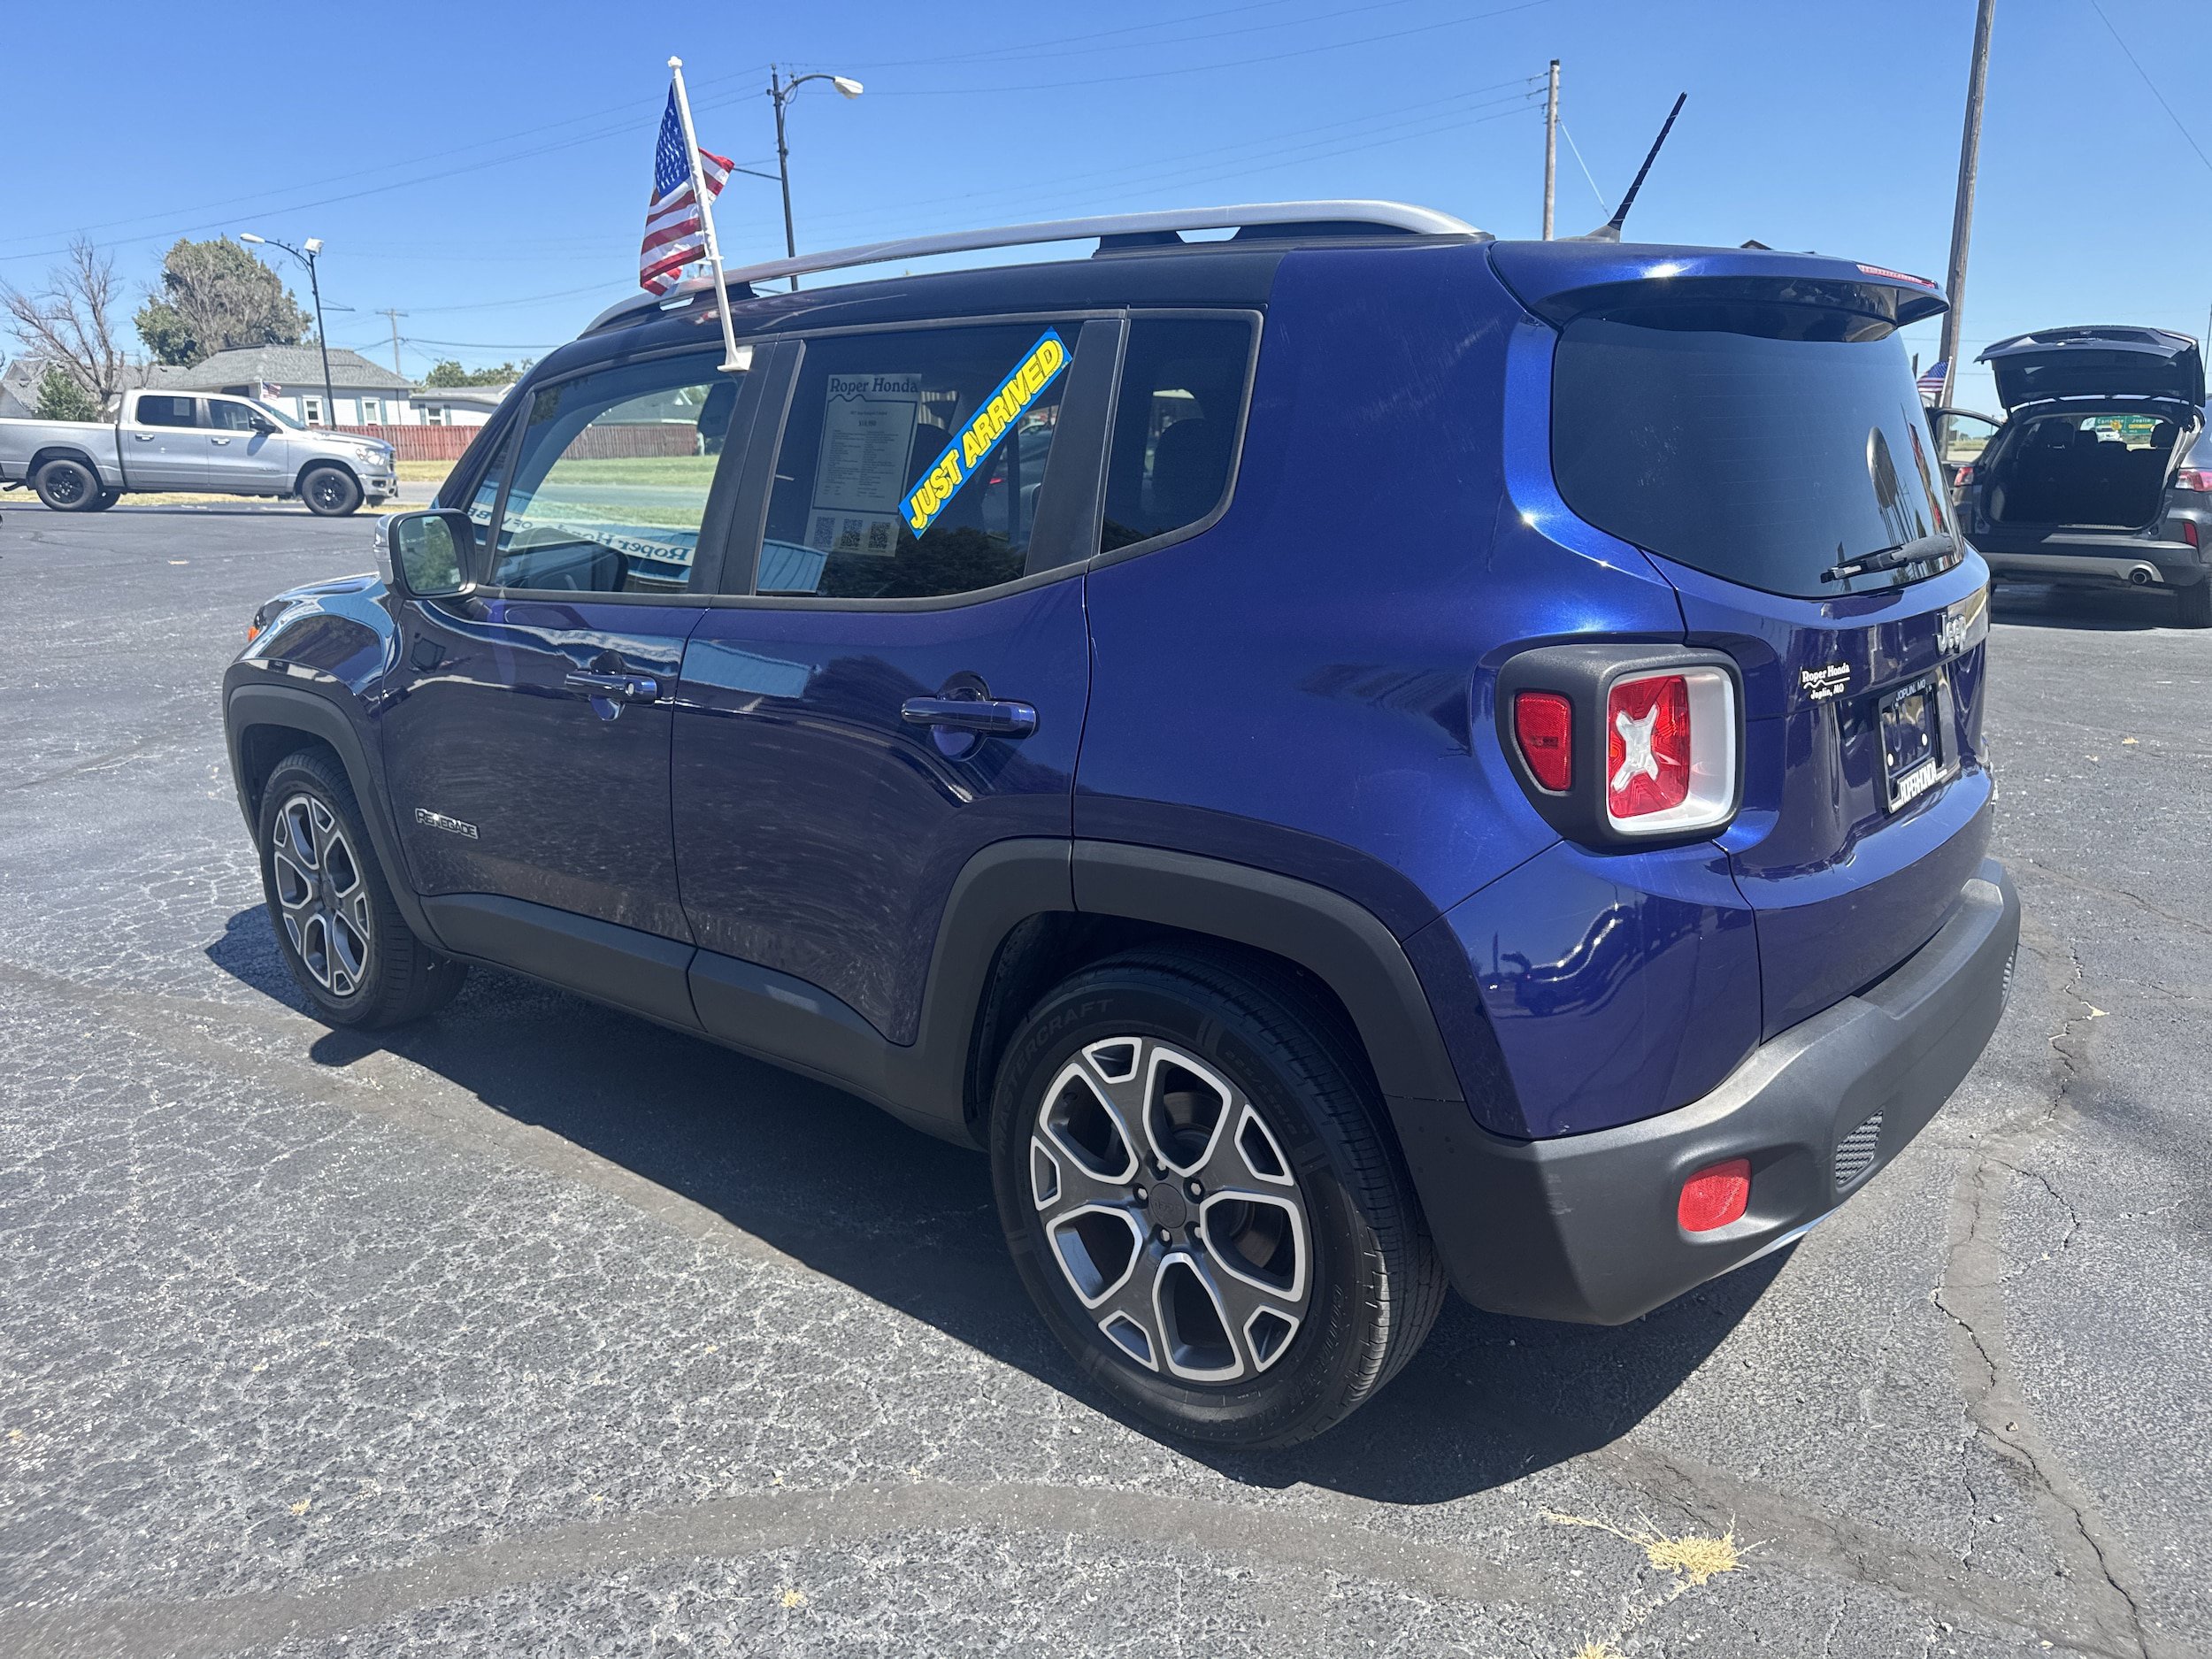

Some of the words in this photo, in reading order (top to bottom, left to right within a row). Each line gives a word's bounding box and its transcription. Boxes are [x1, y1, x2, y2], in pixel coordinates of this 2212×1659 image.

[830, 378, 870, 396] Roper
[872, 377, 918, 393] Honda
[910, 449, 964, 529] JUST
[962, 340, 1064, 469] ARRIVED
[1932, 612, 1966, 655] Jeep
[1801, 670, 1827, 683] Roper
[1827, 663, 1850, 678] Honda
[1833, 683, 1845, 695] MO
[415, 807, 479, 840] RENEGADE
[996, 998, 1115, 1156] MASTERCRAFT
